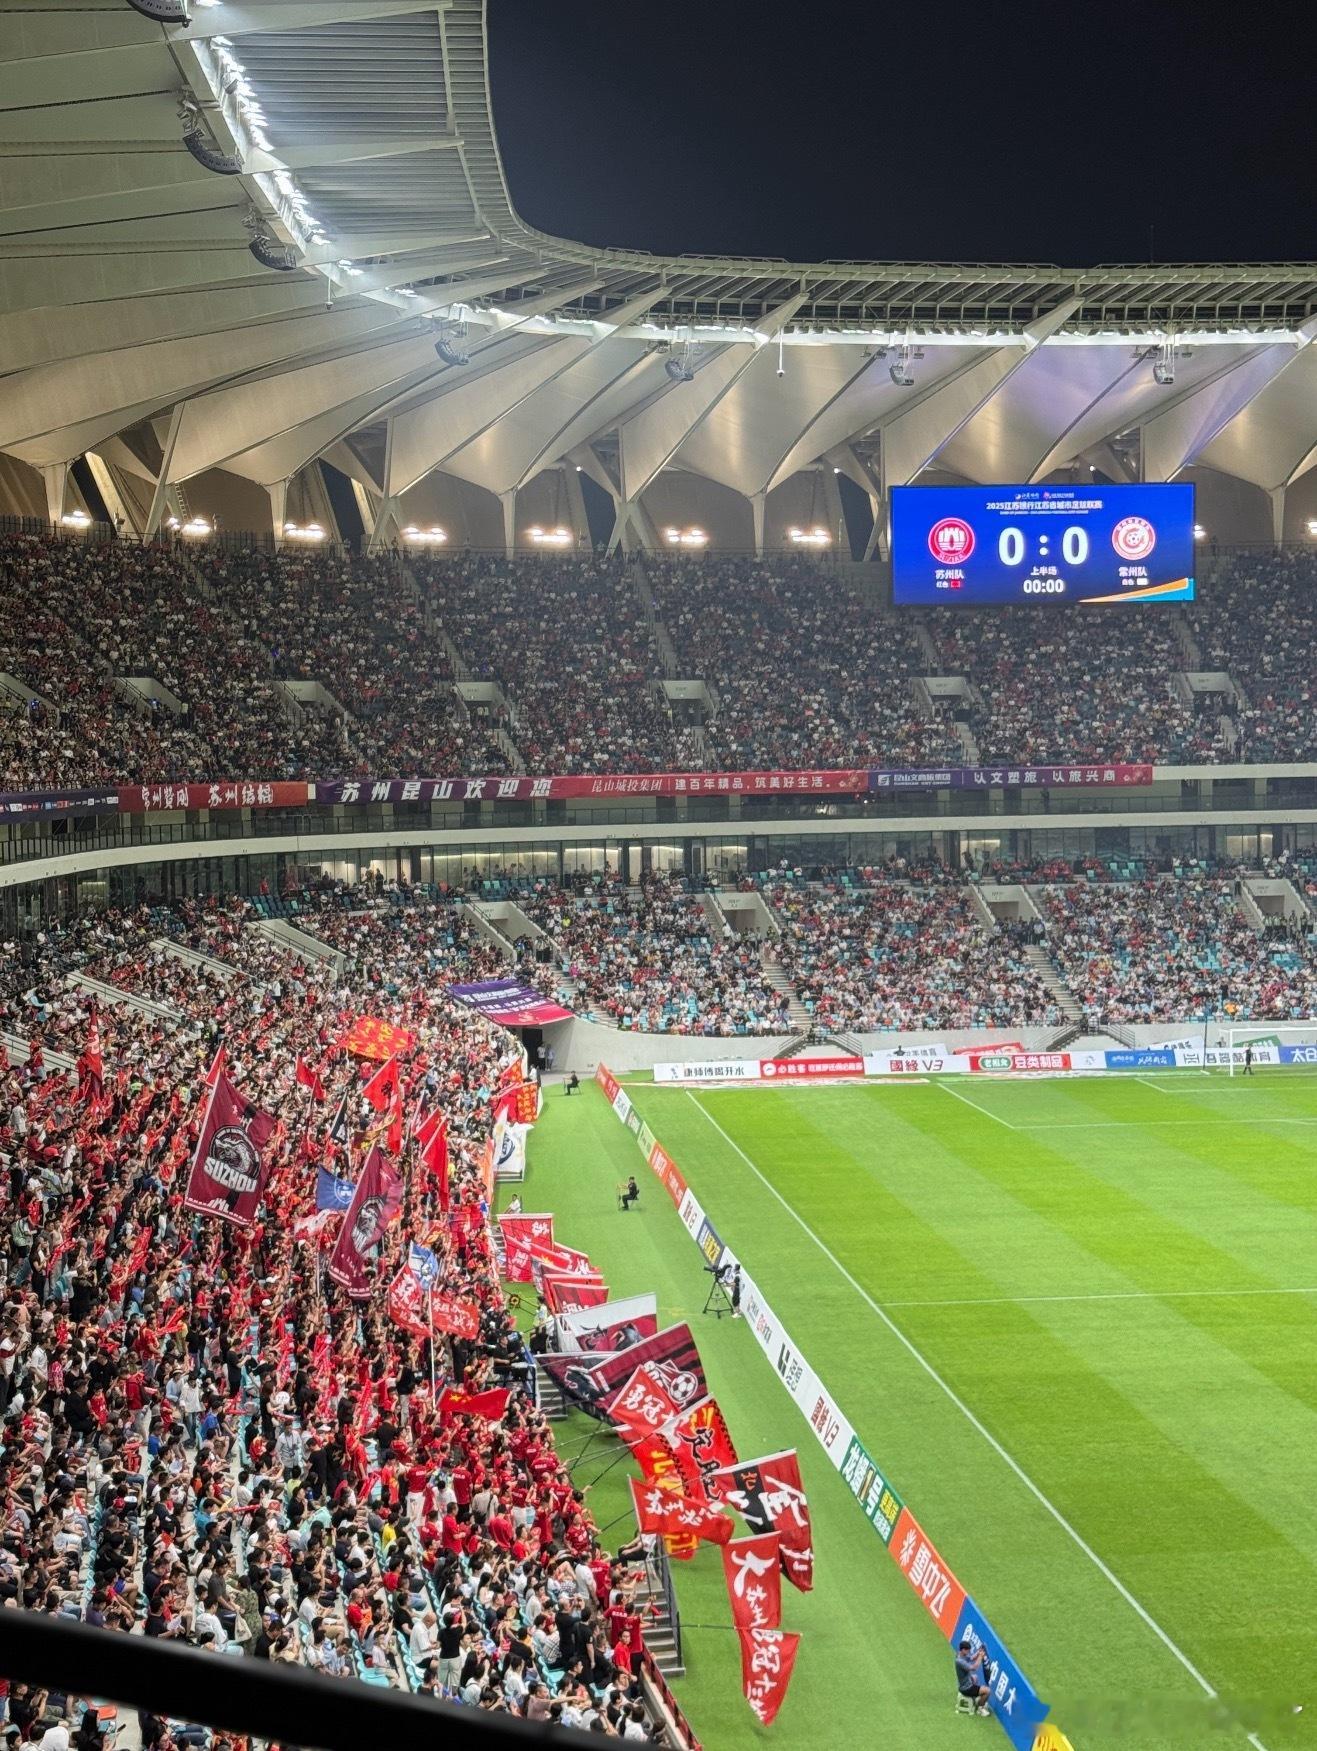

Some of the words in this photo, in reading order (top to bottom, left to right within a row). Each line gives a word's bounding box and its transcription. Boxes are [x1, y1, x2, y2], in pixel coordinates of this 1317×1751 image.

[998, 527, 1025, 566] 0
[1062, 526, 1088, 565] 0
[935, 569, 965, 580] 苏州队
[1030, 566, 1057, 576] 上半场
[1118, 566, 1148, 578] 常州队
[1023, 579, 1064, 594] 00:00
[340, 779, 552, 802] 苏州昆山欢迎您
[592, 778, 664, 793] 昆山城投集团
[777, 1063, 806, 1074] 必胜客
[922, 1060, 944, 1072] V3
[1015, 1056, 1063, 1069] 豆类制品
[683, 1066, 745, 1078] 康师傅喝开水
[203, 1156, 258, 1193] SUZHOU
[909, 1541, 951, 1619] 雪中飞
